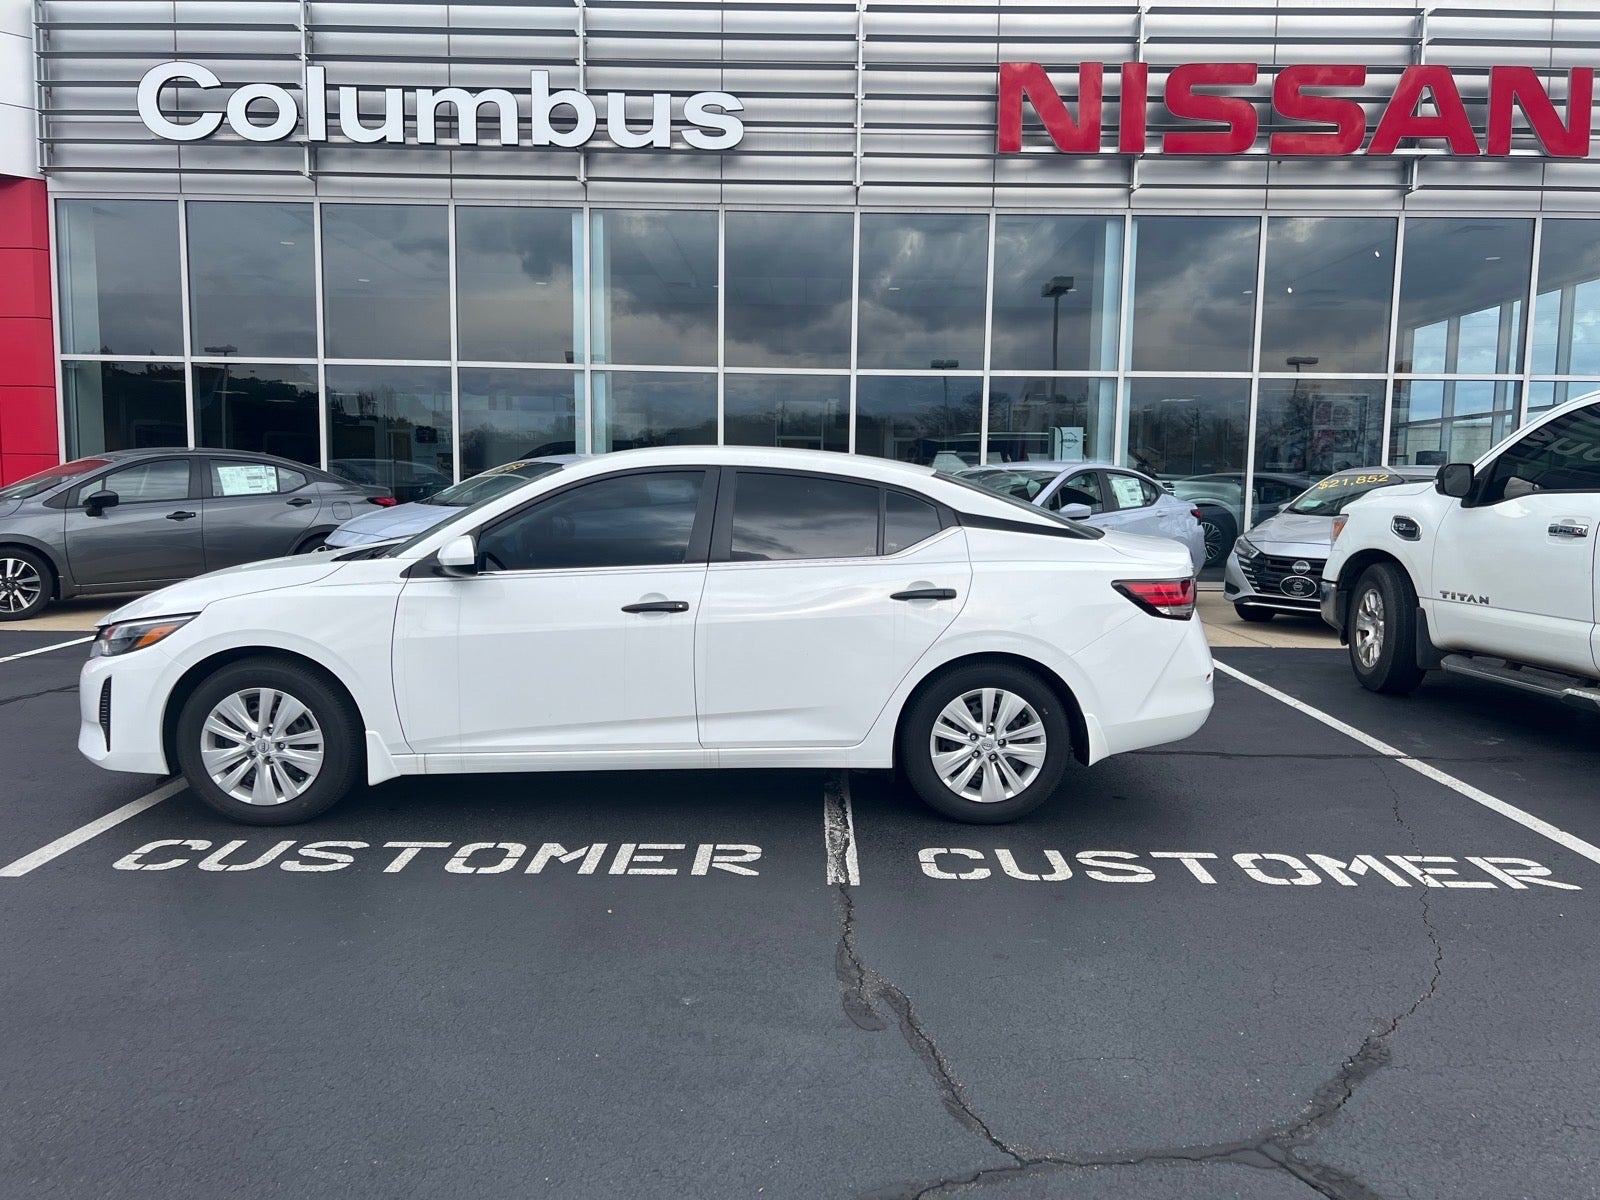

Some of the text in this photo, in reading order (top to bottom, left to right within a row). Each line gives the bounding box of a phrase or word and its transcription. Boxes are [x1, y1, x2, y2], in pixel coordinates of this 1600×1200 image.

[136, 61, 1594, 158] Columbus NISSAN
[1318, 474, 1389, 490] $21,852
[1440, 590, 1490, 605] TITAN
[111, 838, 763, 877] CUSTOMER
[918, 847, 1583, 890] CUSTOMER
